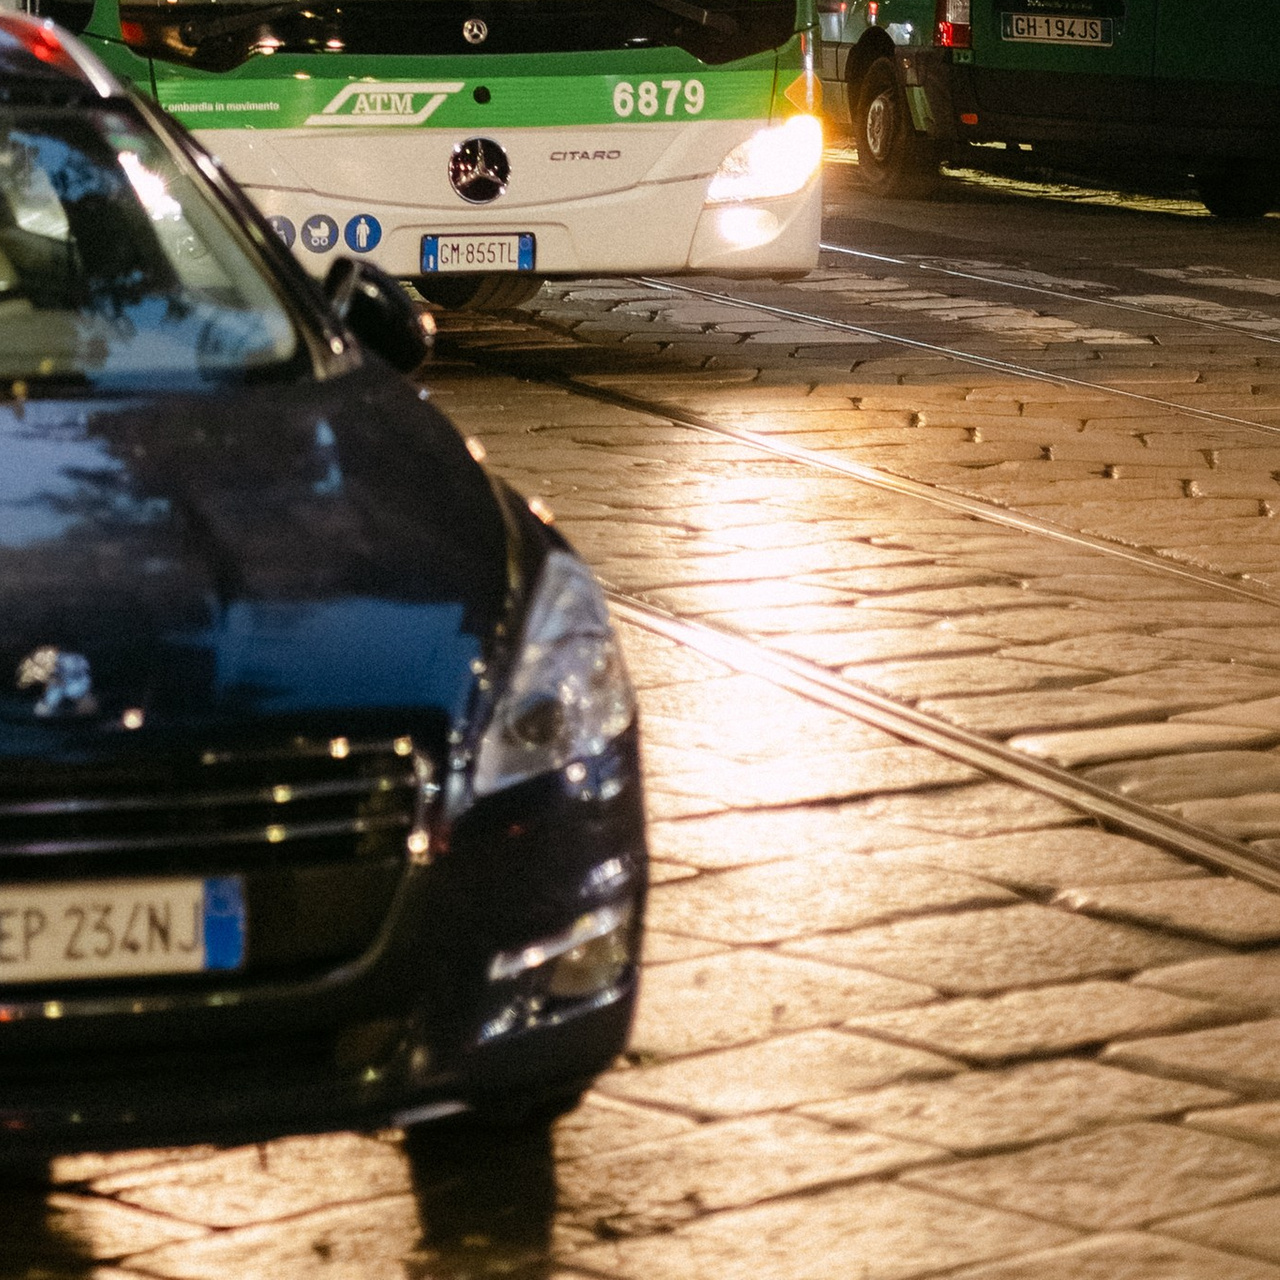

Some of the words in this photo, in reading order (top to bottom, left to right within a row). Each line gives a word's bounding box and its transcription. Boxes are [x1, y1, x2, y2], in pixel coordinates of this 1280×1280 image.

[215, 101, 225, 112] in
[226, 100, 280, 112] movimento
[351, 93, 414, 115] ATM
[613, 79, 705, 117] 6879
[550, 150, 621, 161] CITARO
